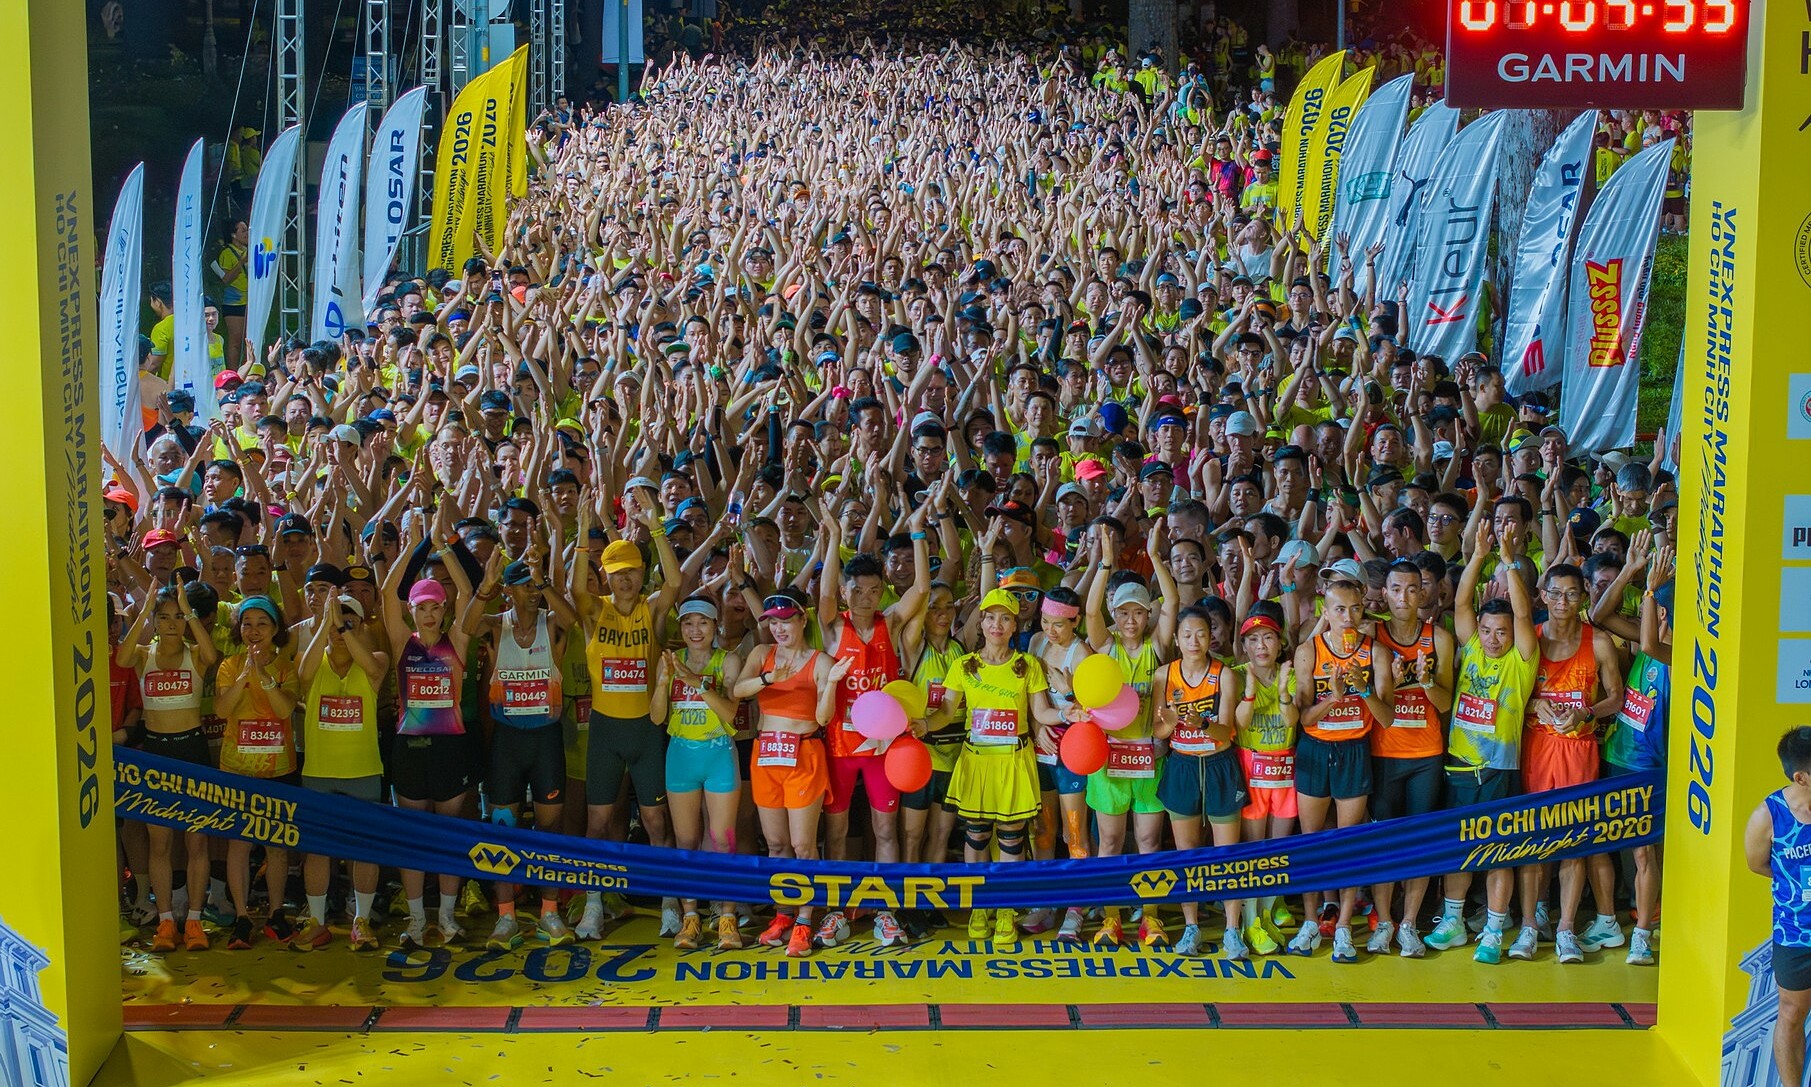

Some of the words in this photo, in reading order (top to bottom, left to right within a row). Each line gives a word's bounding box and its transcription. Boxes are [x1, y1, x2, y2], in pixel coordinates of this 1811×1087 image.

[1498, 53, 1685, 82] GARMIN
[1300, 87, 1323, 137] 2026
[451, 111, 473, 166] 2026
[1324, 106, 1350, 157] 2026
[1318, 159, 1333, 213] MARATHON
[55, 193, 65, 235] HO
[1711, 200, 1722, 242] HO
[57, 241, 67, 293] CHI
[1427, 197, 1479, 325] Kleur
[1709, 247, 1720, 298] CHI
[1799, 234, 1811, 275] CERTIFIED
[65, 190, 84, 407] VNEXPRESS
[1716, 207, 1737, 423] VNEXPRESS
[59, 297, 71, 378] MINH
[1706, 303, 1718, 380] MINH
[63, 384, 74, 444] CITY
[1703, 386, 1715, 449] CITY
[74, 413, 93, 622] MARATHON
[1707, 429, 1728, 639] MARATHON
[599, 627, 649, 648] BAYLOR
[157, 681, 189, 691] 80479
[420, 686, 450, 695] 80212
[499, 669, 551, 680] GARMIN
[614, 670, 645, 679] 80474
[330, 708, 360, 718] 82395
[515, 691, 547, 701] 80449
[1329, 706, 1361, 717] 80453
[1395, 704, 1425, 714] 80442
[1465, 706, 1492, 720] 82143
[1625, 700, 1647, 717] 81601
[73, 630, 100, 830] 2026
[250, 731, 282, 741] 83454
[984, 721, 1015, 730] 81860
[1180, 730, 1210, 739] 8044
[1687, 636, 1718, 836] 2026
[767, 743, 795, 753] 88333
[1121, 755, 1152, 765] 81690
[1264, 765, 1292, 775] 83742
[147, 769, 183, 793] CHI
[187, 783, 246, 812] MINH
[250, 794, 298, 822] CITY
[1459, 816, 1493, 842] HO
[1497, 806, 1536, 835] CHI
[1540, 796, 1600, 829] MINH
[1604, 785, 1654, 818] CITY
[114, 789, 237, 833] Midnight
[240, 813, 300, 847] 2026
[520, 849, 628, 872] VnExpress
[1459, 826, 1590, 870] Midnight
[1592, 814, 1653, 844] 2026
[525, 864, 628, 889] Marathon
[1184, 855, 1290, 878] VnExpress
[1186, 871, 1290, 893] Marathon
[769, 872, 985, 908] START
[381, 943, 661, 983] 2026
[674, 959, 974, 982] MARATHON
[985, 957, 1297, 979] VNEXPRESS
